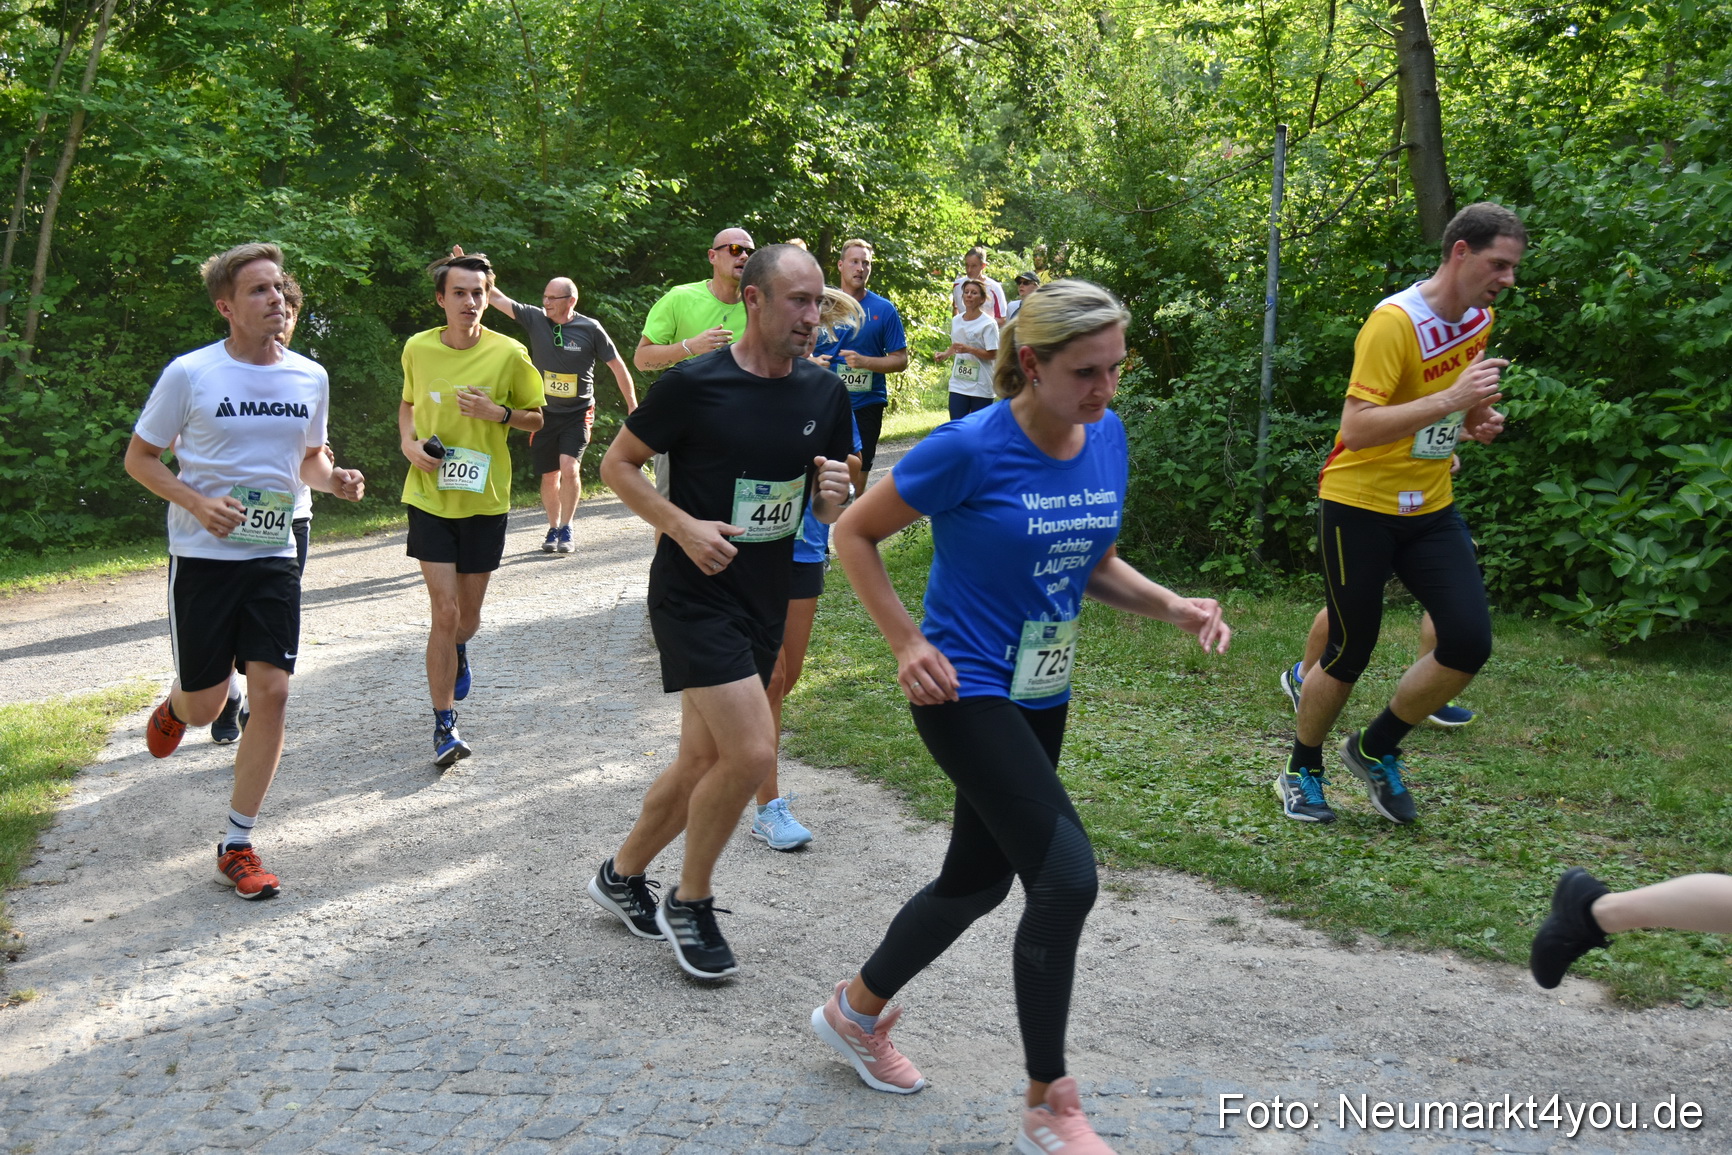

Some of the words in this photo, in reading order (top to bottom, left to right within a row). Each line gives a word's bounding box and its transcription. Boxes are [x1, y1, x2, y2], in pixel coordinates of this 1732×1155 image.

[841, 373, 868, 385] 2047
[958, 365, 972, 375] 684
[1423, 354, 1462, 383] MAX
[550, 381, 570, 392] 428
[239, 401, 309, 419] MAGNA
[1425, 424, 1461, 446] 154
[441, 462, 480, 480] 1206
[1021, 493, 1067, 510] Wenn
[1068, 493, 1083, 507] es
[1083, 488, 1118, 506] beim
[750, 501, 792, 526] 440
[1027, 510, 1119, 535] Hausverkauf
[1047, 538, 1094, 555] richtig
[1033, 555, 1092, 577] LAUFEN
[1034, 646, 1071, 677] 725
